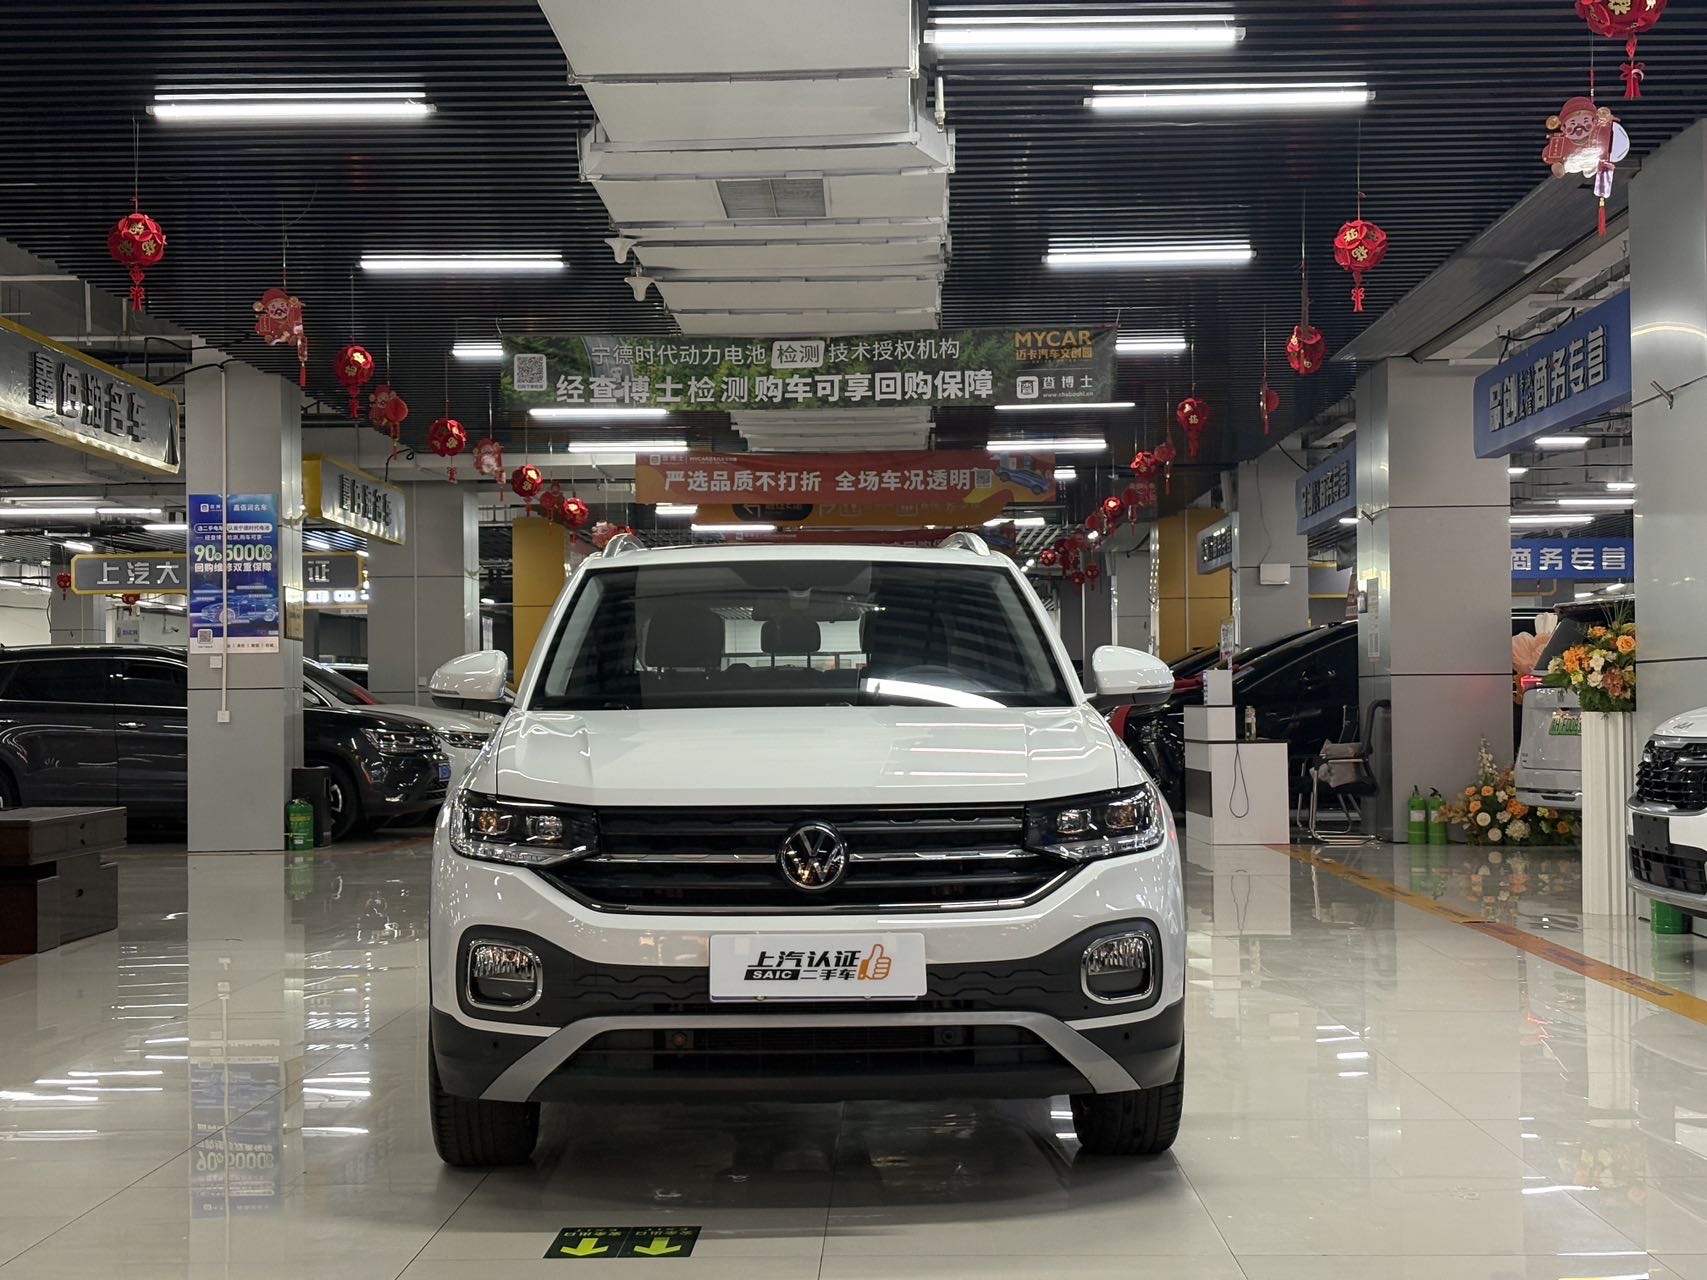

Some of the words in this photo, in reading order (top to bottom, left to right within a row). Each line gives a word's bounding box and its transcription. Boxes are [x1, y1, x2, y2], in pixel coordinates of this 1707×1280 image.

[1015, 330, 1092, 347] MYCAR
[591, 345, 766, 365] 宁德时代动力电池
[776, 344, 820, 365] 检测
[829, 338, 961, 363] 技术授权机构
[556, 370, 994, 404] 经查博士检测购车可享回购保障
[664, 470, 821, 492] 严选品质不打折
[834, 468, 971, 490] 全场车况透明
[1511, 547, 1626, 571] 商务专营
[97, 561, 180, 585] 上汽大
[748, 950, 861, 968] 上汽认证
[752, 970, 792, 979] SAIC
[800, 968, 856, 980] 二手车
